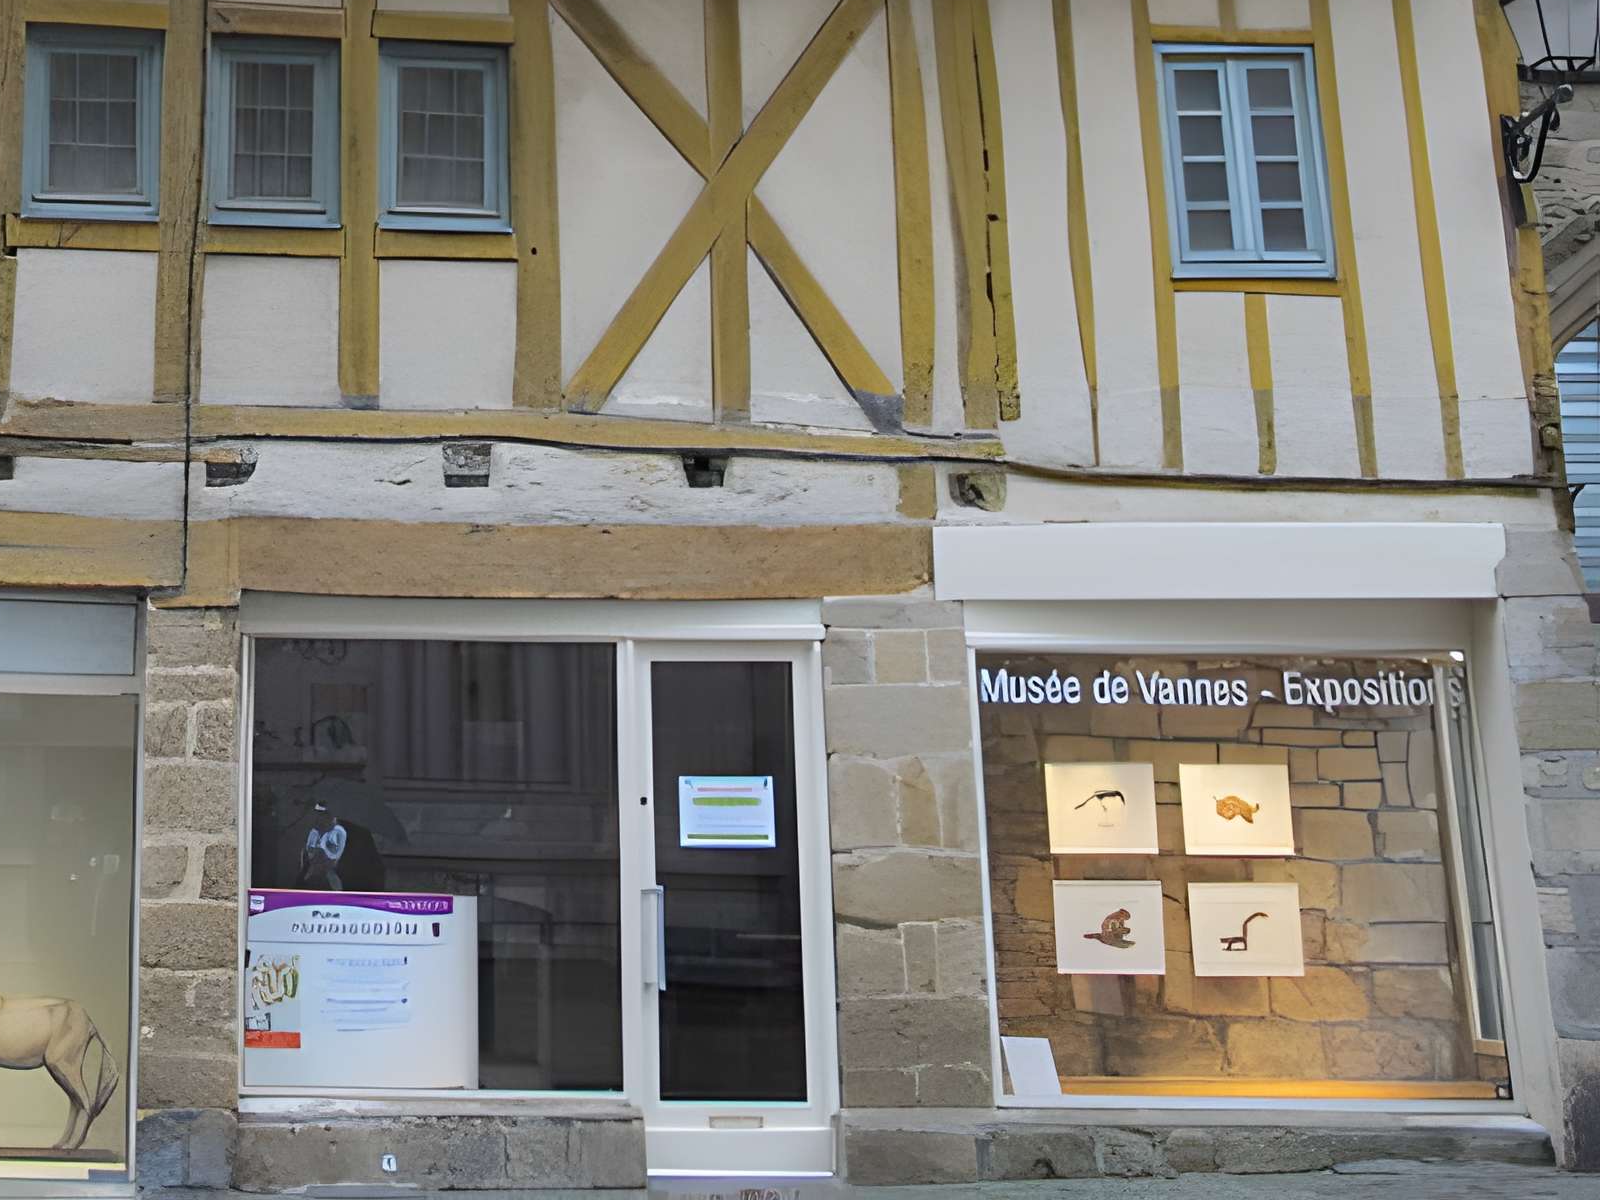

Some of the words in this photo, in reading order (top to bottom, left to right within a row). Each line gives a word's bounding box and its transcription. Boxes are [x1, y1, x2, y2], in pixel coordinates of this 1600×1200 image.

[980, 668, 1081, 704] Musée
[1093, 669, 1129, 704] de
[1136, 669, 1248, 706] Vannes
